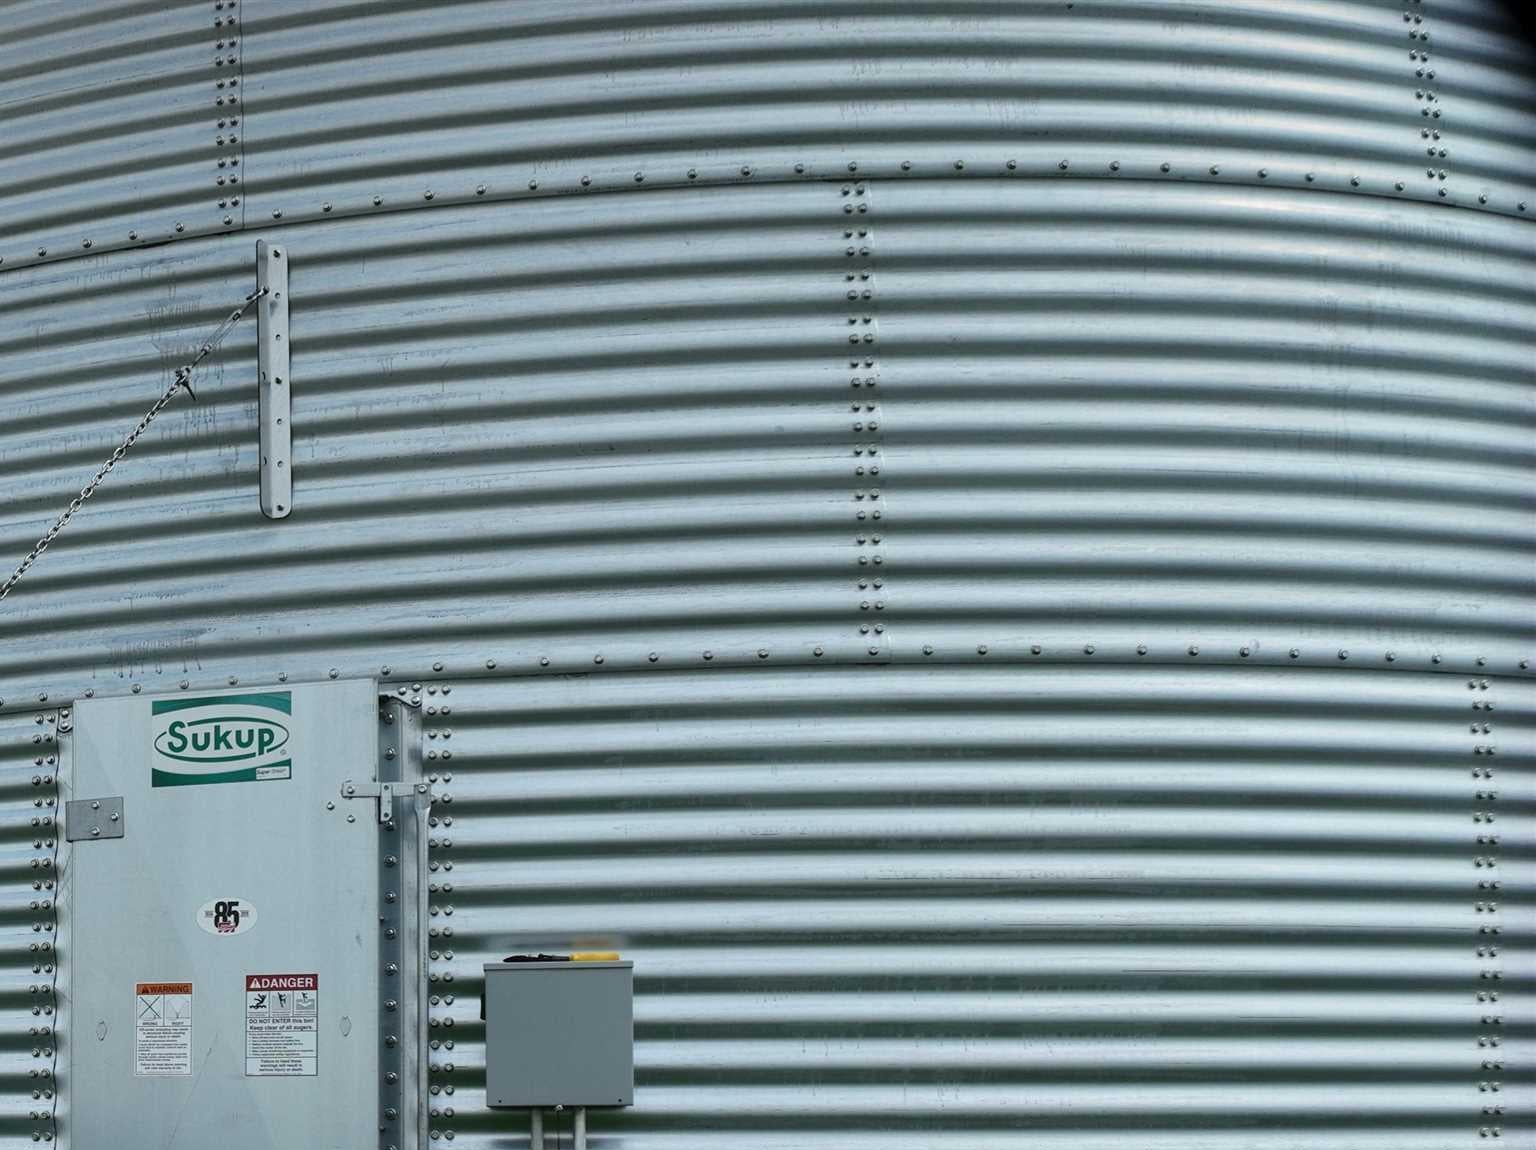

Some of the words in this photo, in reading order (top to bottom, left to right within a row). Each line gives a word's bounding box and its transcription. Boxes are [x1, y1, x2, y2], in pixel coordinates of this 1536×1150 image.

[167, 720, 275, 756] Sukup
[214, 901, 240, 930] 85
[150, 985, 189, 993] WARNING
[262, 977, 313, 988] DANGER
